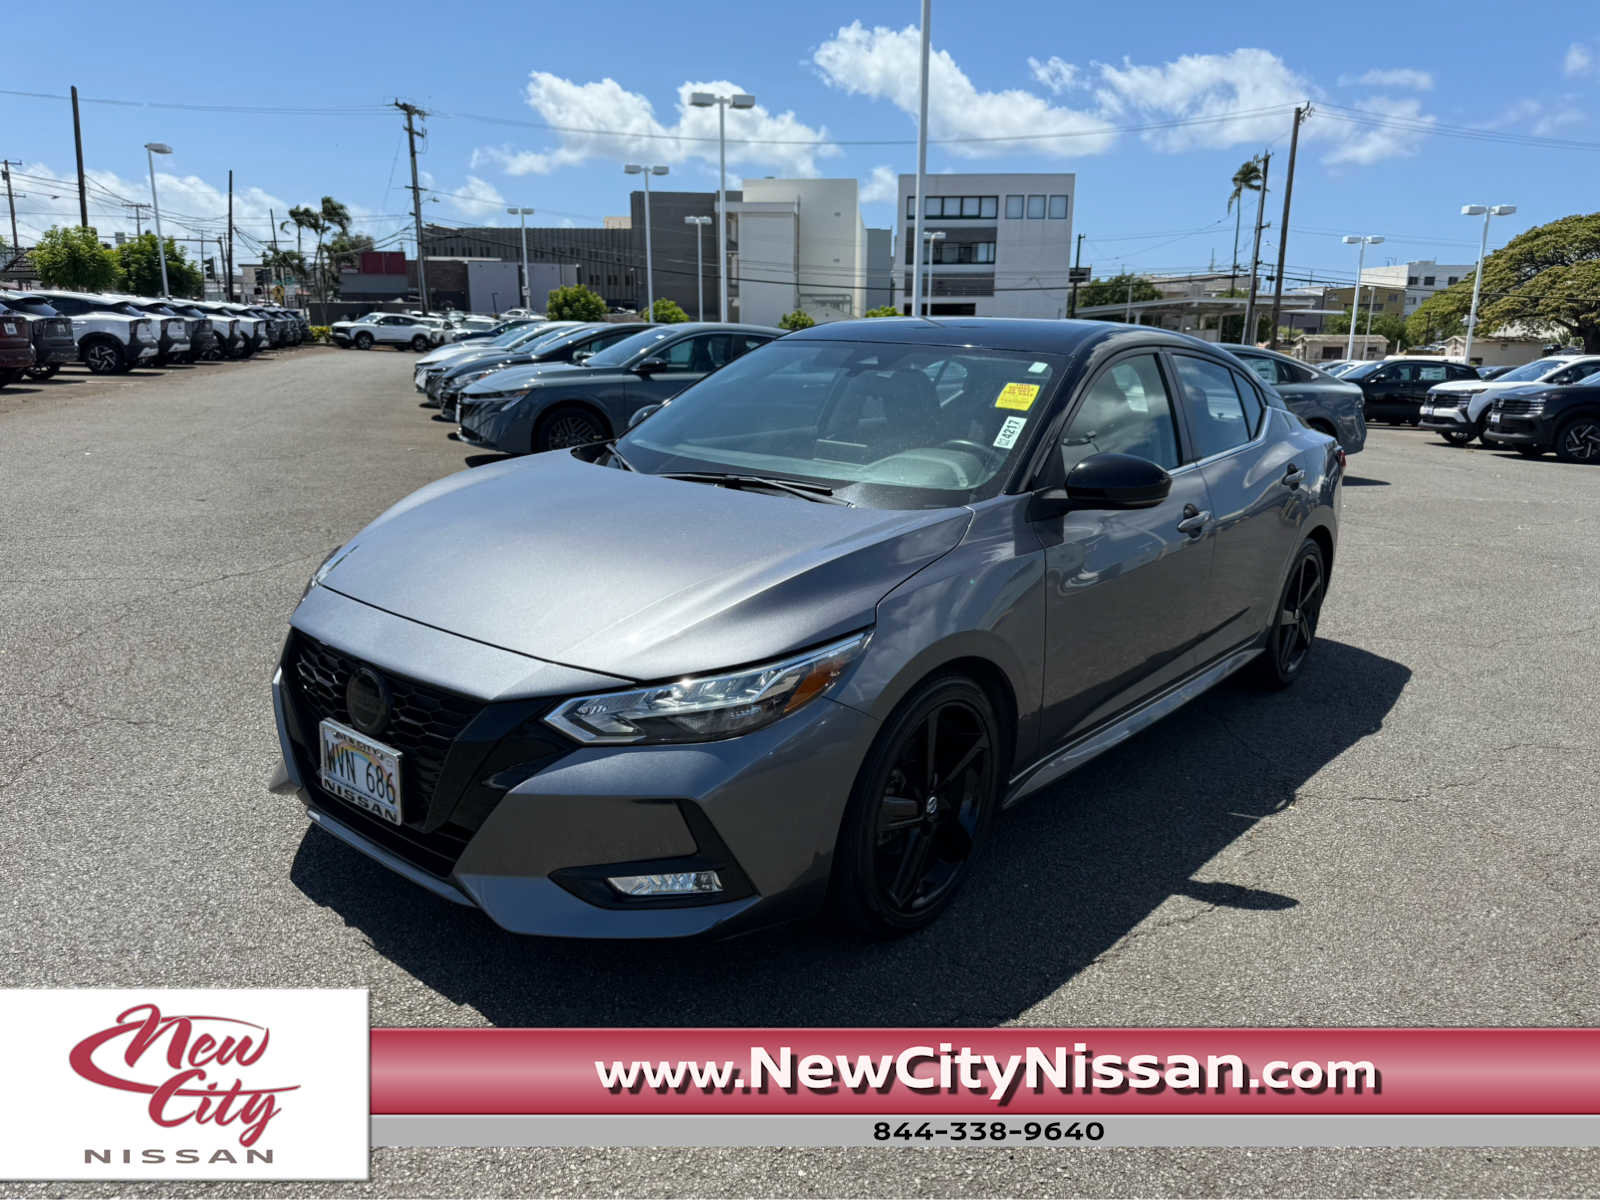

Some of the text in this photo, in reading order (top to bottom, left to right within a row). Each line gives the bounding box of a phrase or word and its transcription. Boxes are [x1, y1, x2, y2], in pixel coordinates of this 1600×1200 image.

[1002, 420, 1020, 439] 4217
[324, 780, 397, 822] NISSAN
[366, 761, 396, 804] 686
